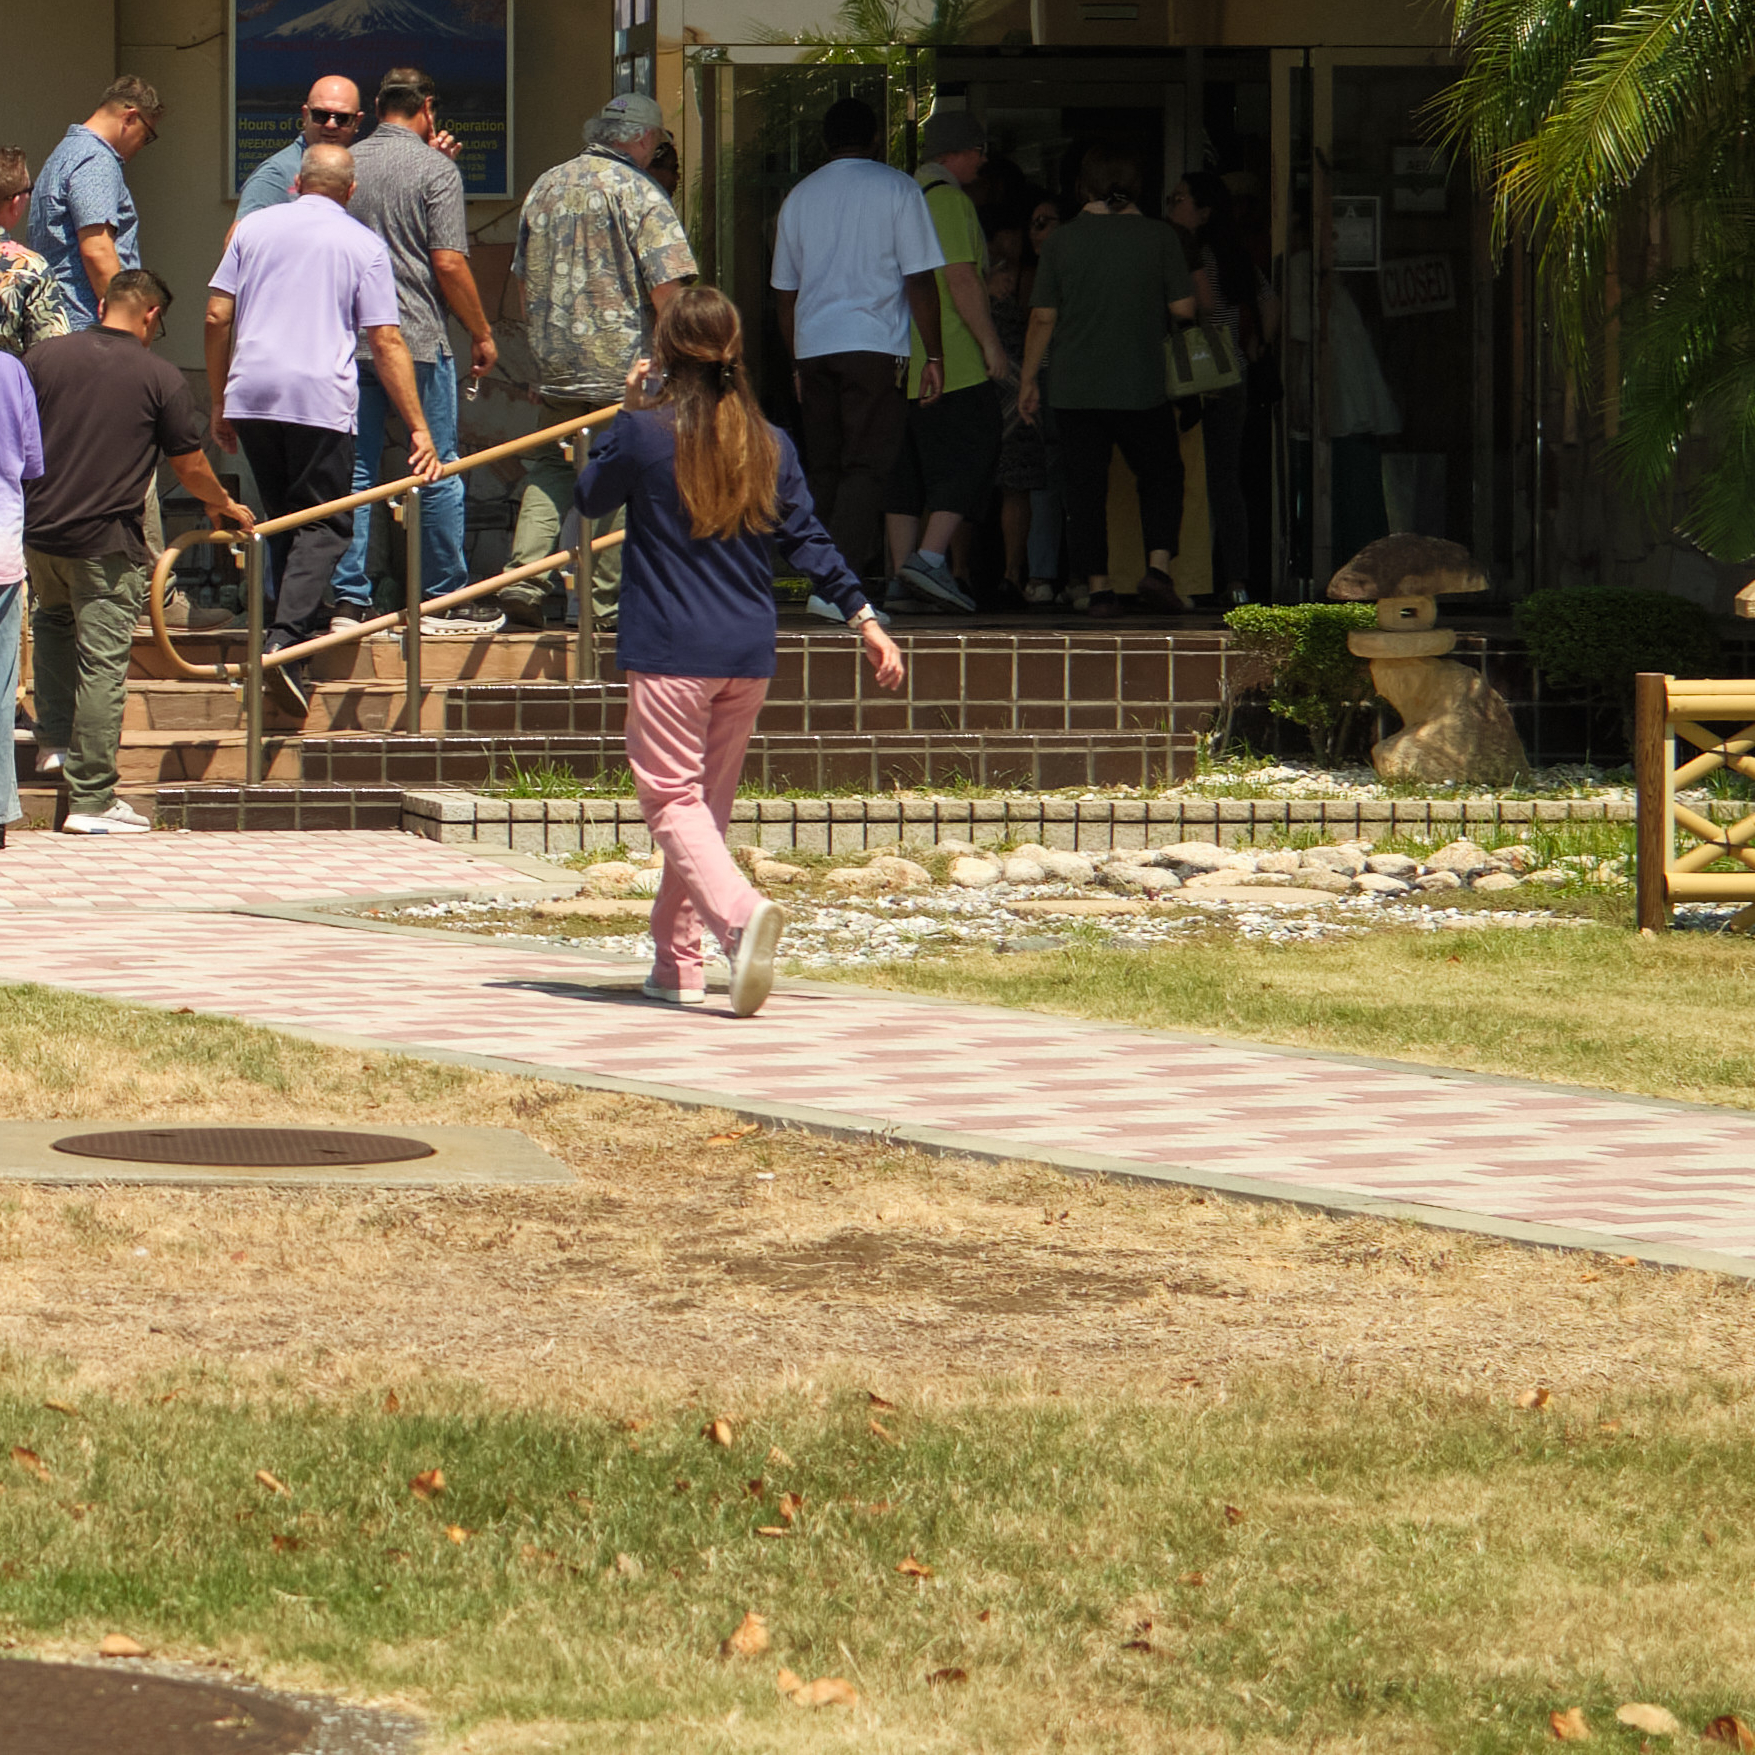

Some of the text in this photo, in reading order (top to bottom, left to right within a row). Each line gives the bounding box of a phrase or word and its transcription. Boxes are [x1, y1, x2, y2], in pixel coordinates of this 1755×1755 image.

[238, 117, 276, 130] Hours
[445, 118, 505, 133] Operation
[1384, 260, 1449, 308] CLOSED
